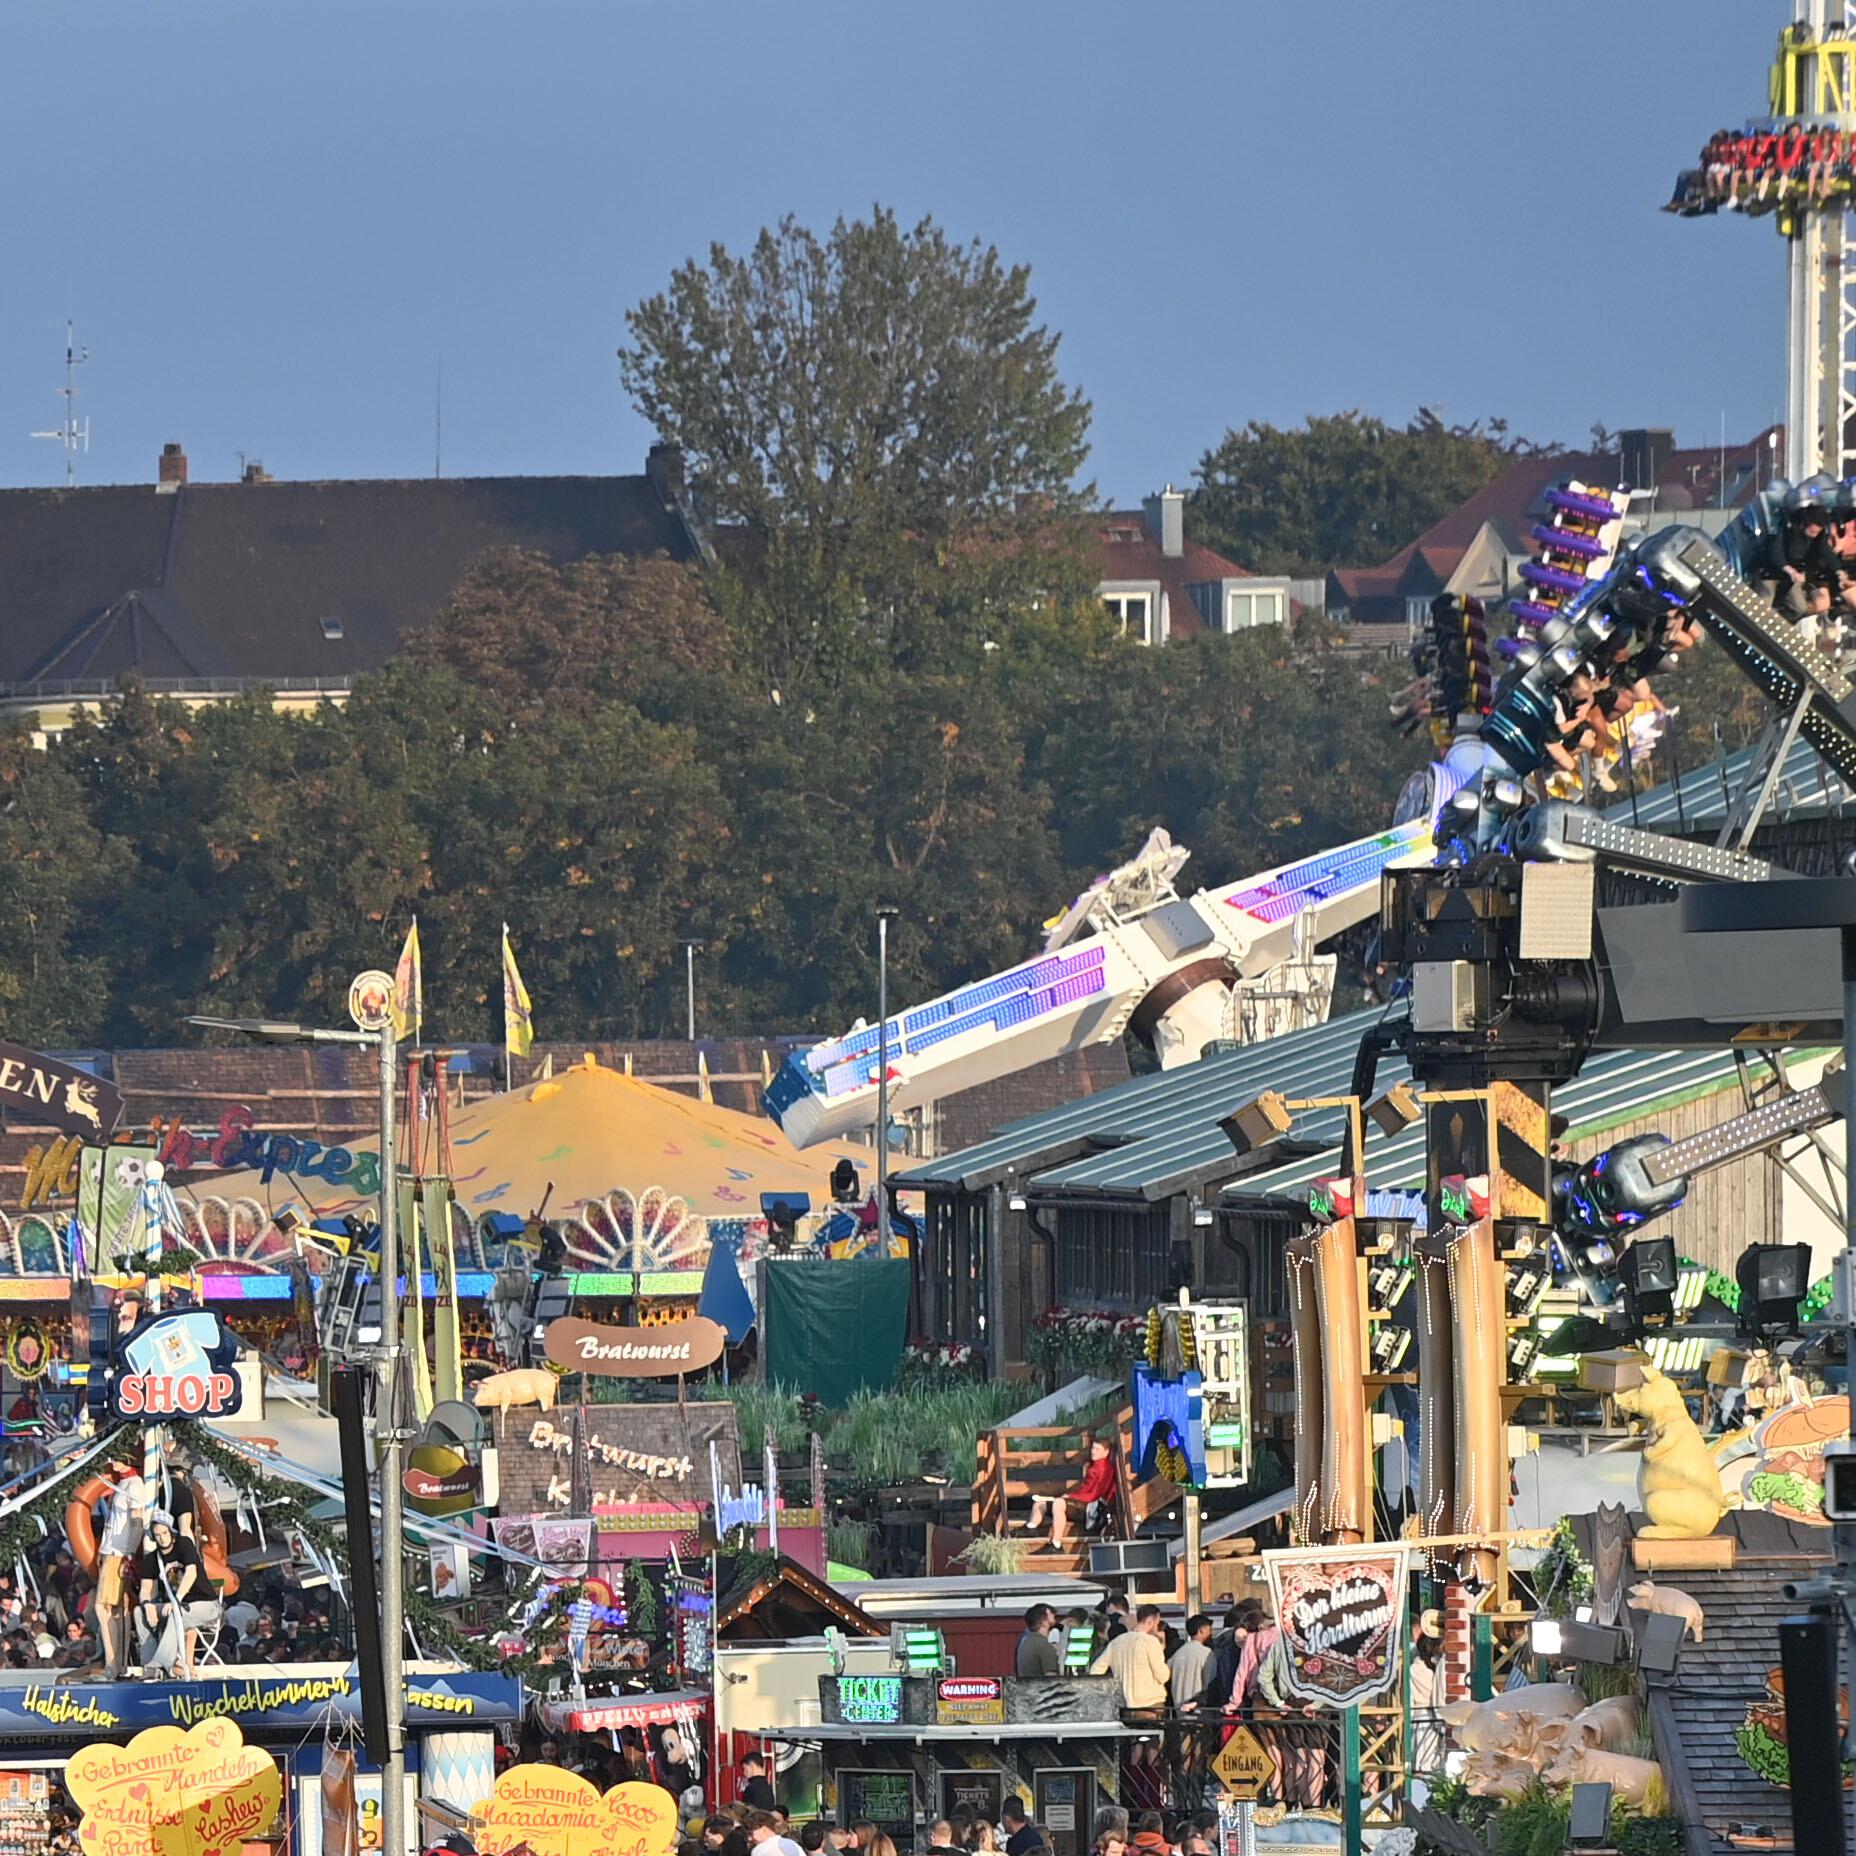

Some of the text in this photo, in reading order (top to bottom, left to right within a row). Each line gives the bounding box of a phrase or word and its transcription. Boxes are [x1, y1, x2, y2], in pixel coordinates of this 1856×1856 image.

[575, 1335, 690, 1360] Bratwurst
[119, 1374, 233, 1413] SHOP
[837, 1678, 902, 1702] TICKET
[942, 1684, 997, 1695] WARNING
[22, 1684, 120, 1729] Halstücher
[169, 1676, 350, 1725] Wäscheklammern
[406, 1690, 474, 1714] assen
[82, 1743, 194, 1782] Gebrannte
[1222, 1754, 1263, 1771] EINGANG
[499, 1781, 593, 1806] Gebrannte
[483, 1804, 600, 1829] Macadamia
